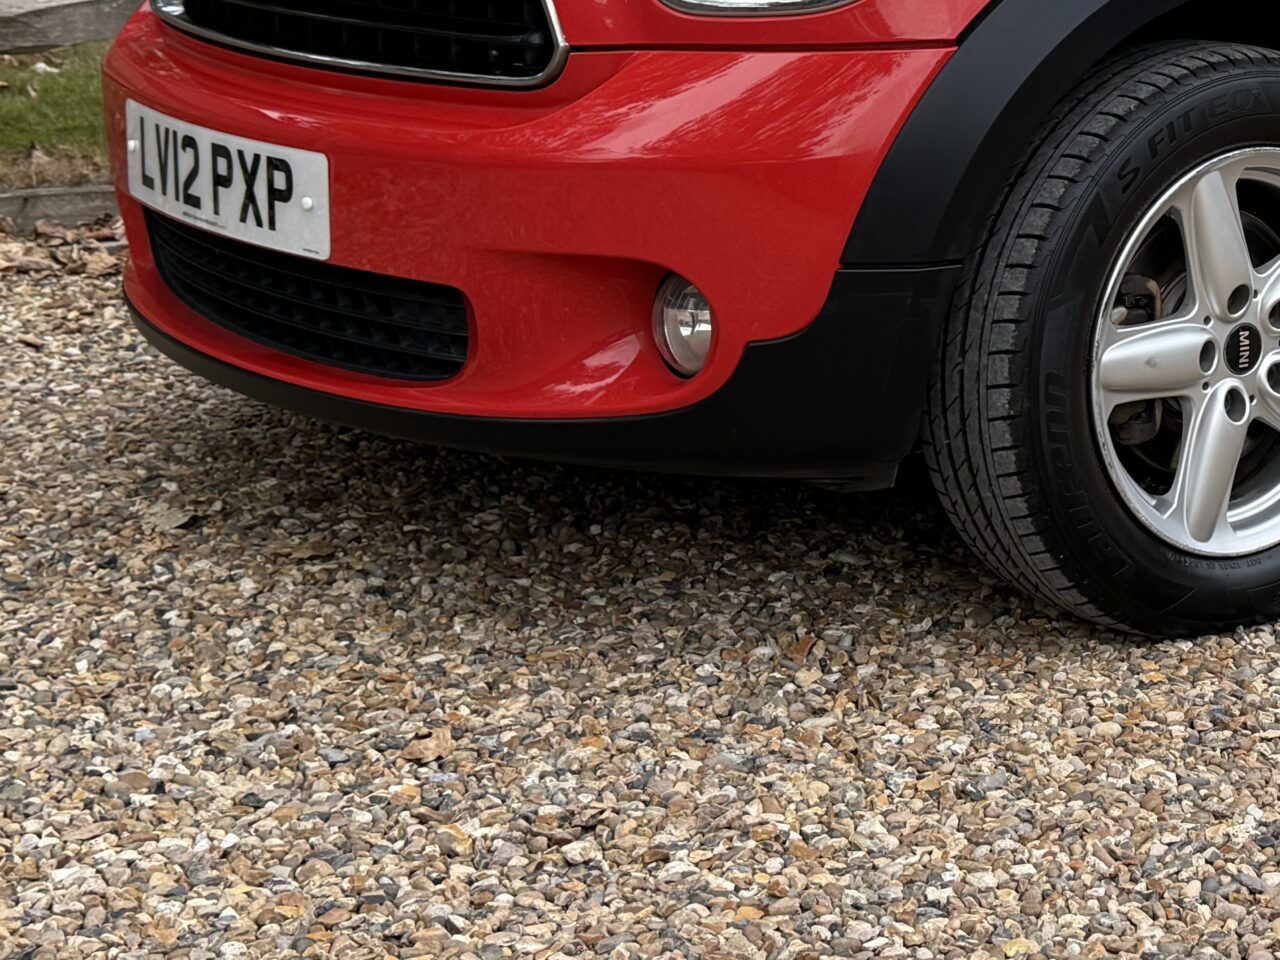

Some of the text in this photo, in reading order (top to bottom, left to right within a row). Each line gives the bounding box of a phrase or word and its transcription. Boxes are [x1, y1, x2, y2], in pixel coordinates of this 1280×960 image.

[139, 116, 294, 231] LV12 PXP
[1116, 157, 1142, 194] S
[1147, 106, 1198, 161] FIT
[1238, 330, 1250, 369] MINI
